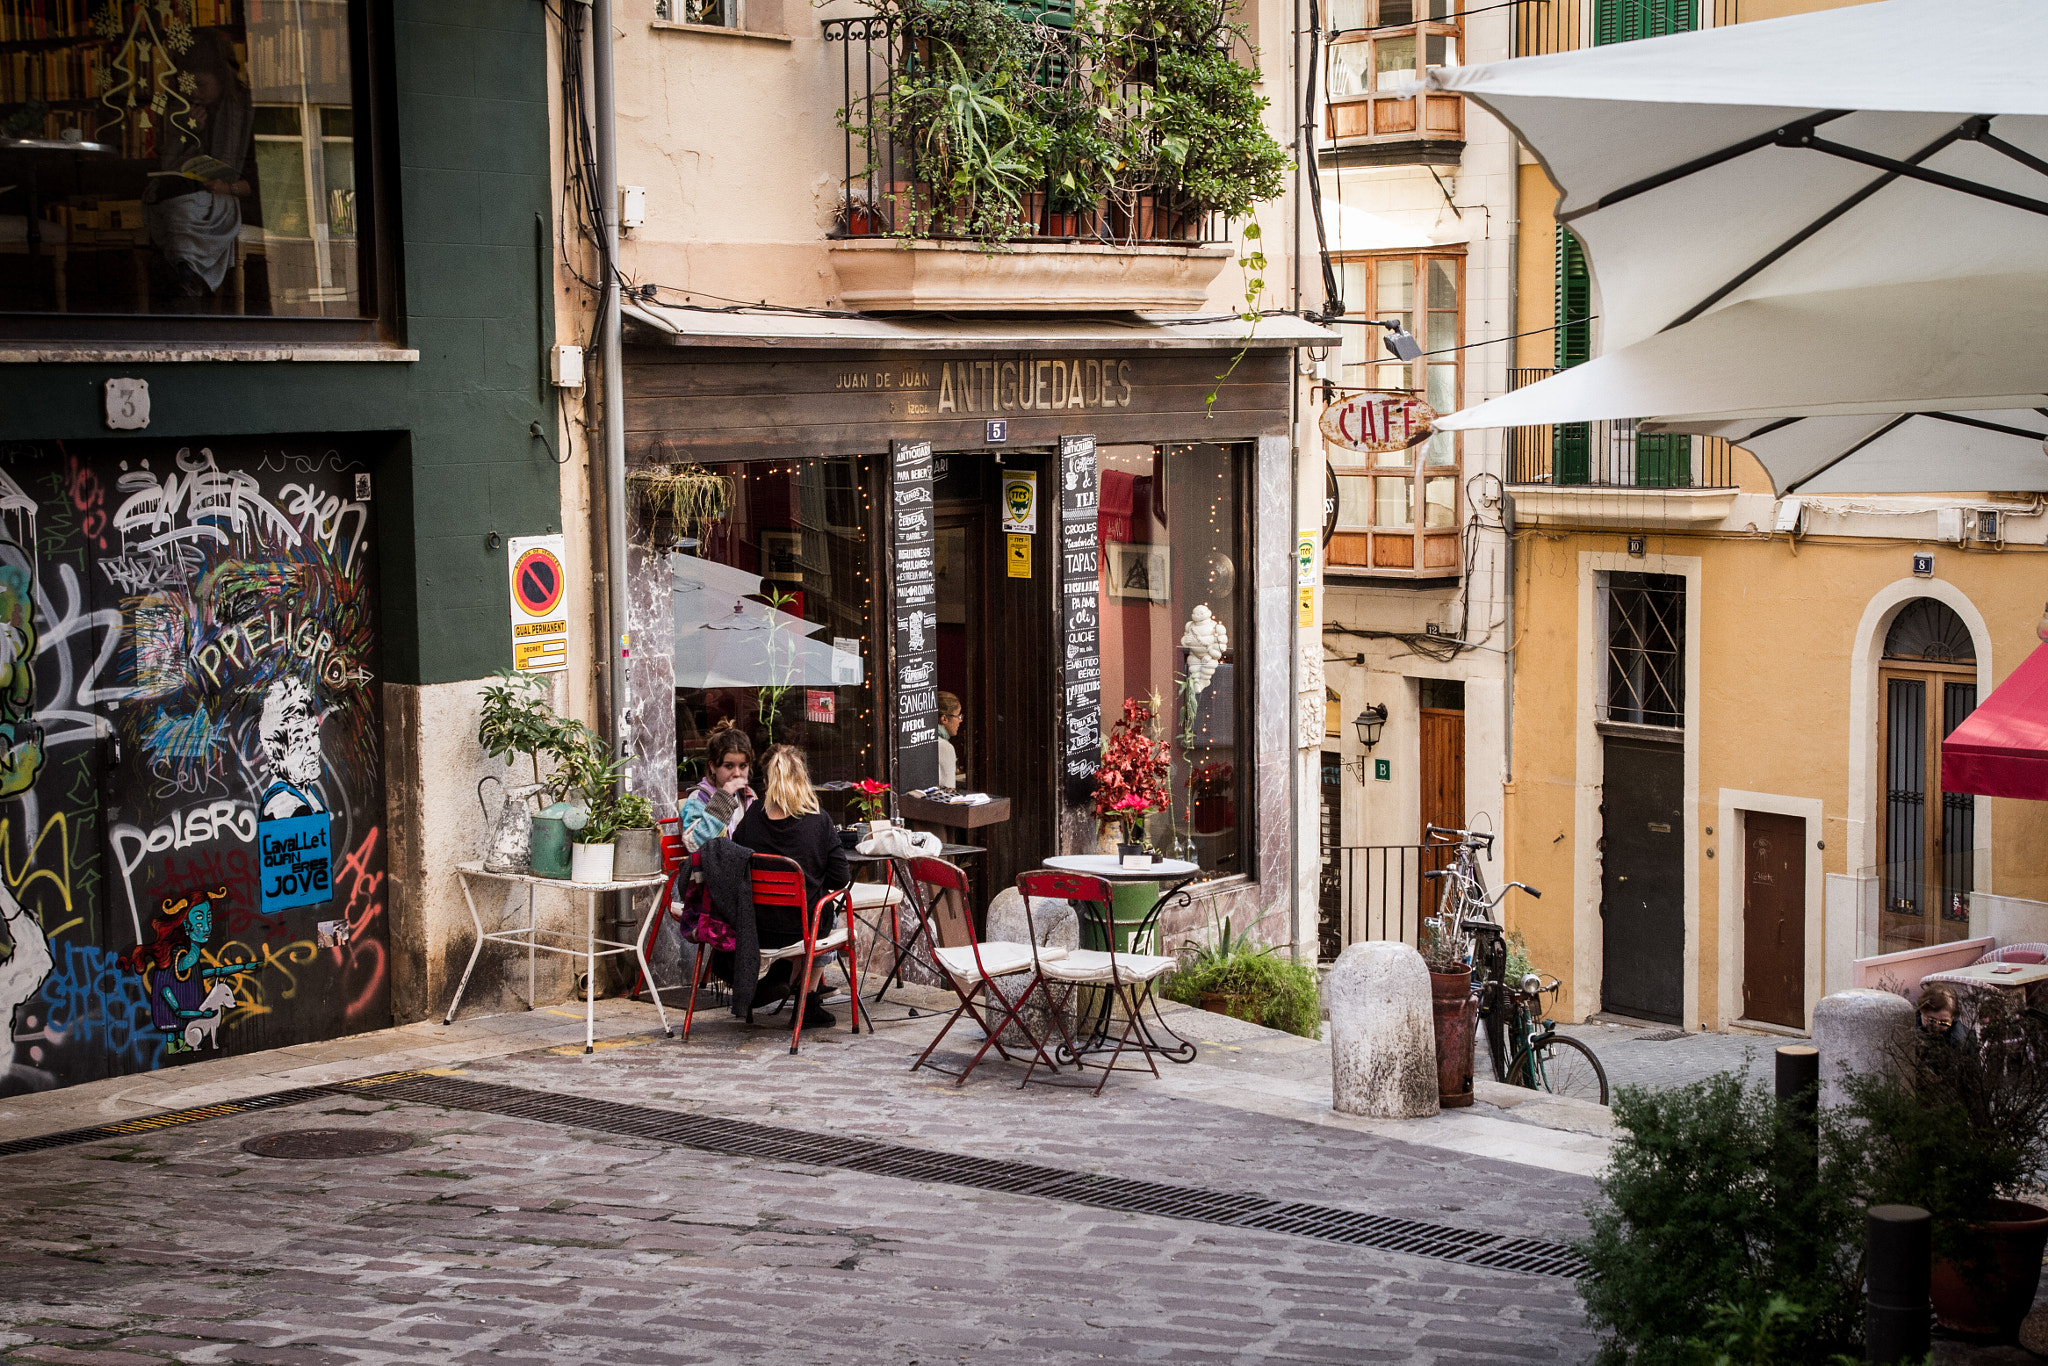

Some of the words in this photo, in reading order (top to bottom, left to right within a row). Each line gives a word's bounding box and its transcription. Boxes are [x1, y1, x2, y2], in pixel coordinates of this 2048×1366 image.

[836, 373, 868, 389] JUAN
[876, 373, 891, 388] DE
[898, 371, 929, 387] JUAN
[938, 353, 1132, 414] ANTIGÜEDADES
[119, 389, 136, 419] 3
[992, 424, 1000, 438] 5
[897, 470, 909, 481] PARA
[911, 468, 928, 480] BEBER
[903, 489, 920, 502] VINOS
[1075, 492, 1095, 508] TEA
[1065, 522, 1097, 535] CROQUES
[1630, 541, 1639, 552] 10
[1065, 552, 1097, 573] TAPAS
[1918, 559, 1926, 570] 8
[1072, 597, 1080, 610] PA
[1081, 595, 1096, 609] AMB
[516, 624, 531, 636] GUAL
[532, 622, 564, 634] PERMANENT
[1428, 625, 1438, 635] 12
[1069, 630, 1096, 643] QUICHE
[1066, 658, 1099, 670] EMBUTIDO
[900, 687, 937, 714] SANGRÍA
[902, 718, 926, 733] APEROL
[911, 729, 936, 744] SPRITZ
[1379, 763, 1387, 776] B
[264, 852, 300, 867] QUAN
[292, 858, 328, 873] ERES
